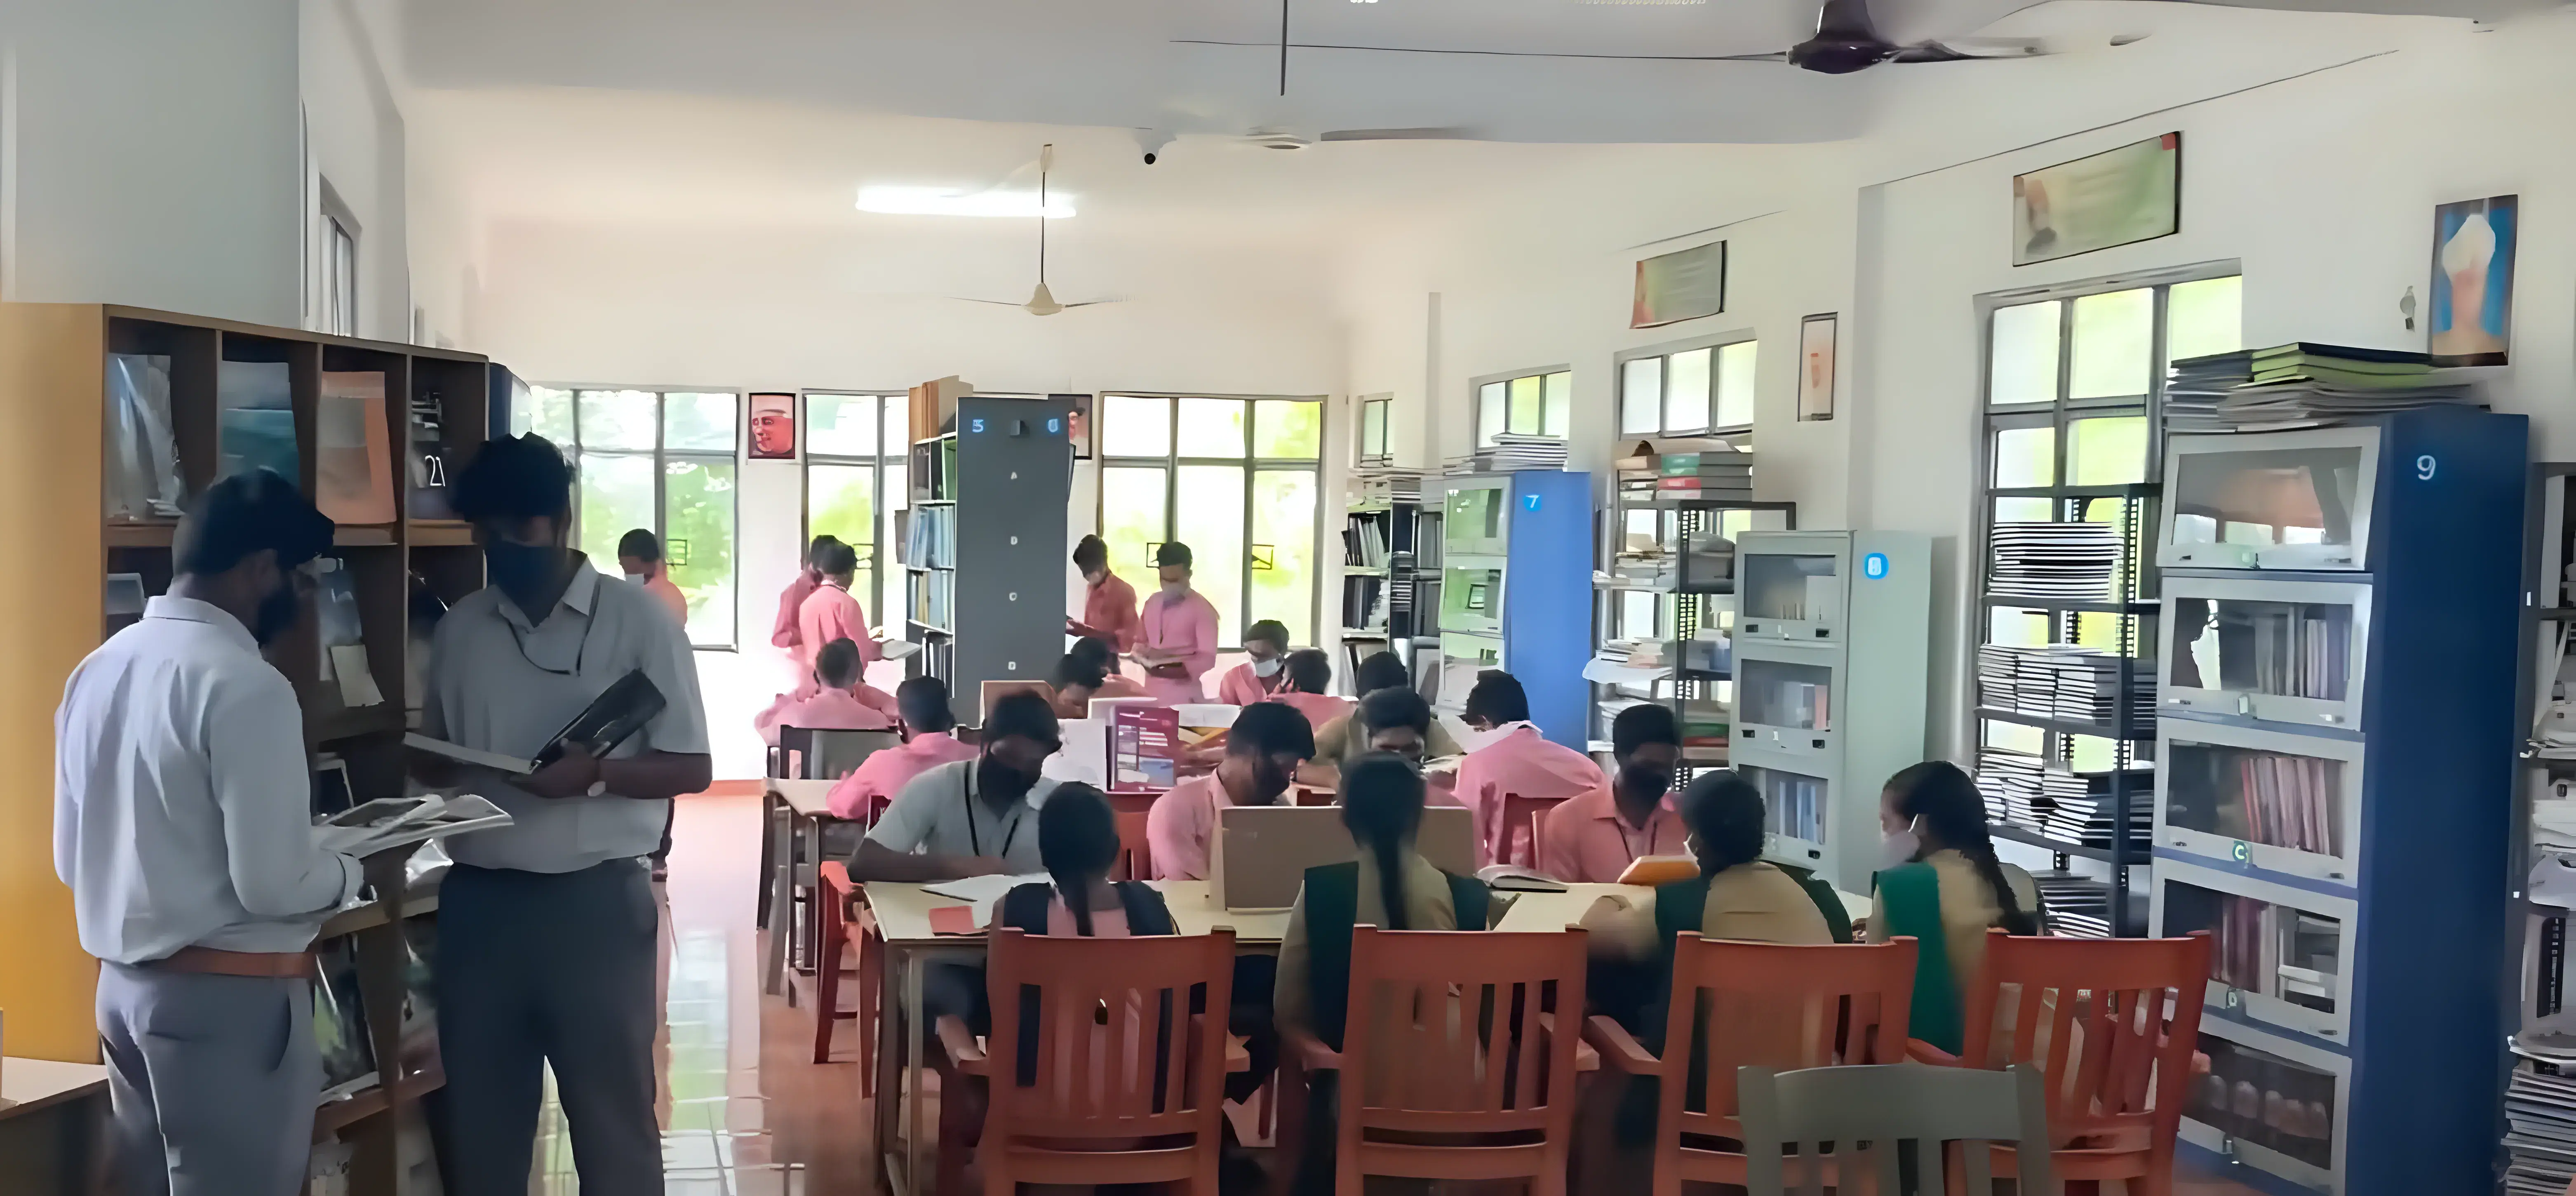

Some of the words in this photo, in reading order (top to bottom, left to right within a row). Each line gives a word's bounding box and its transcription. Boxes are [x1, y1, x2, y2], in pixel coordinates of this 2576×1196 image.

[973, 419, 983, 433] 5
[2417, 454, 2436, 480] 9
[1525, 494, 1540, 508] 7
[2235, 845, 2245, 859] C
